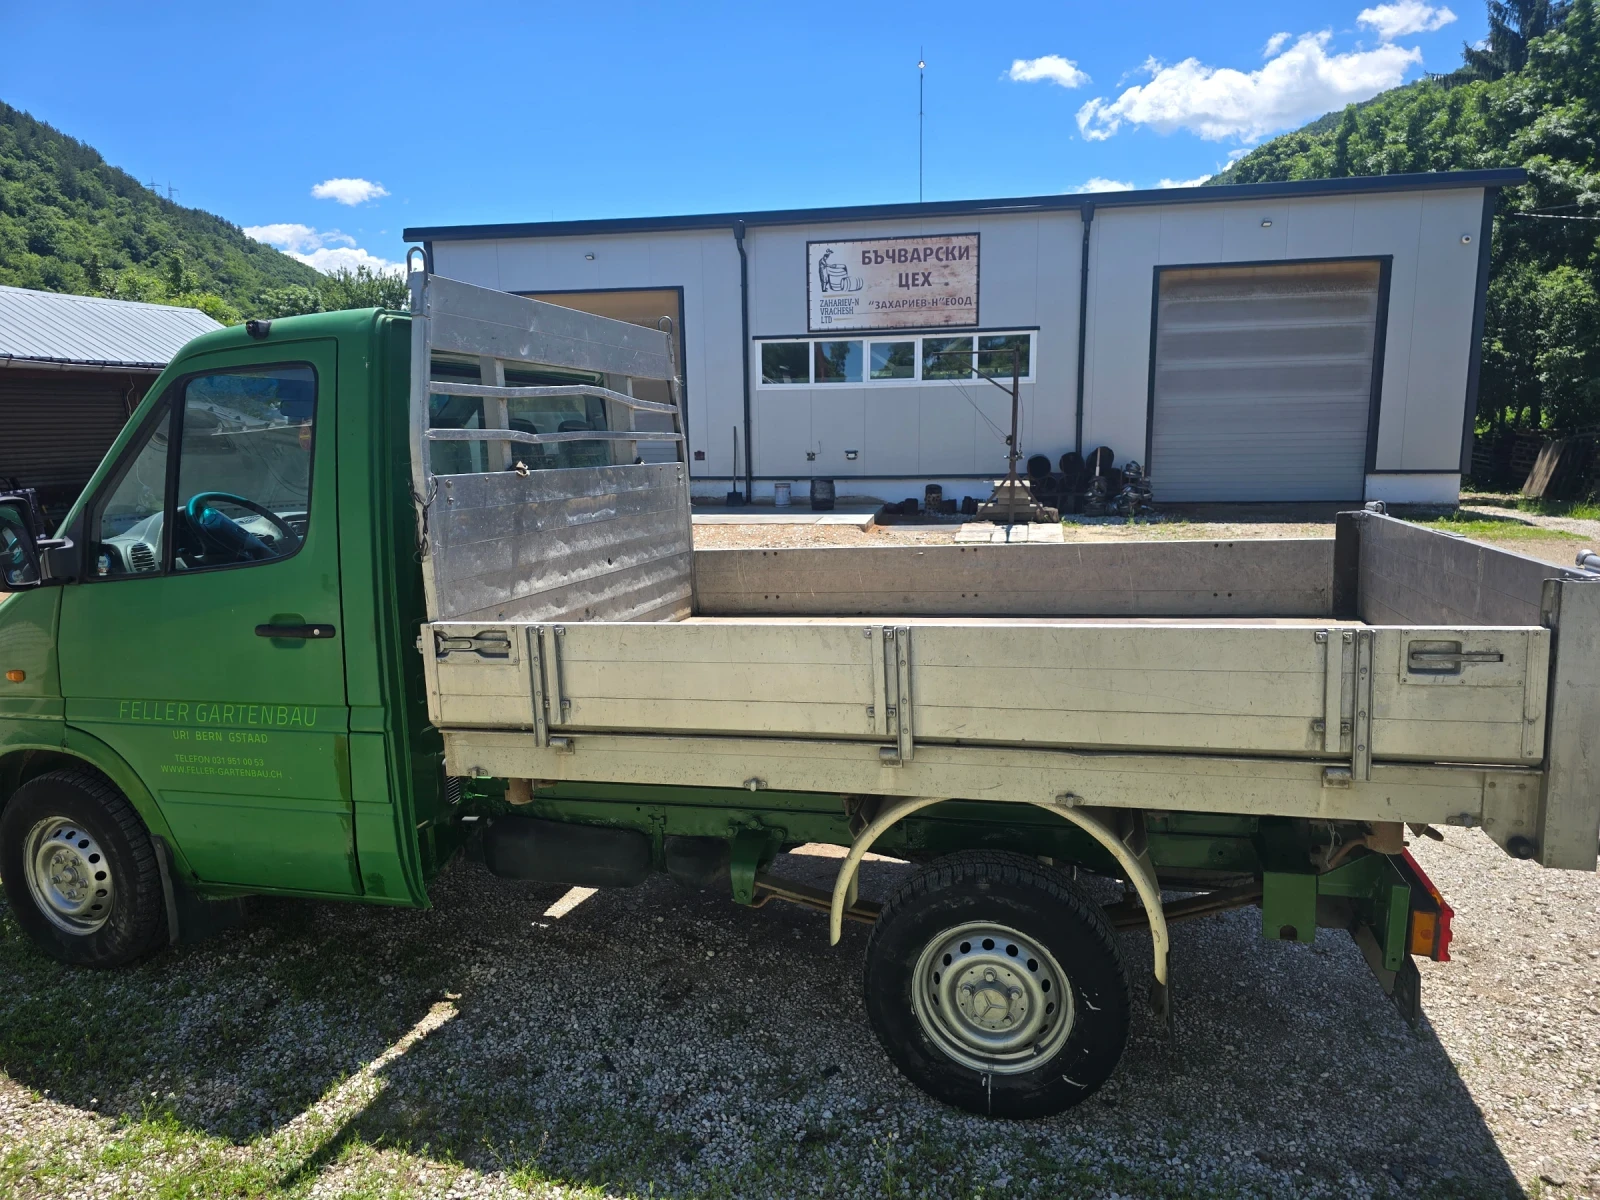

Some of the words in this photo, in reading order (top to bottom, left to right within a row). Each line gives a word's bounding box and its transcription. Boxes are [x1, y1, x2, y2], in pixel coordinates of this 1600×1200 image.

[861, 245, 970, 266] БЪЧВАРСКИ
[898, 271, 932, 291] ЦЕХ
[820, 306, 854, 316] VRACHESH
[820, 315, 833, 324] LTD
[119, 700, 189, 722] FELLER
[195, 703, 317, 727] GARTENBAU
[172, 730, 189, 740] URI
[195, 731, 223, 742] BERN
[228, 732, 268, 744] GSTAAD
[174, 754, 211, 764] TELEFON
[212, 756, 226, 765] 031
[227, 757, 241, 766] 951
[242, 758, 253, 766] 00
[254, 758, 264, 767] 53
[160, 764, 283, 779] WWW.FELLER-GARTENBAU.CH
